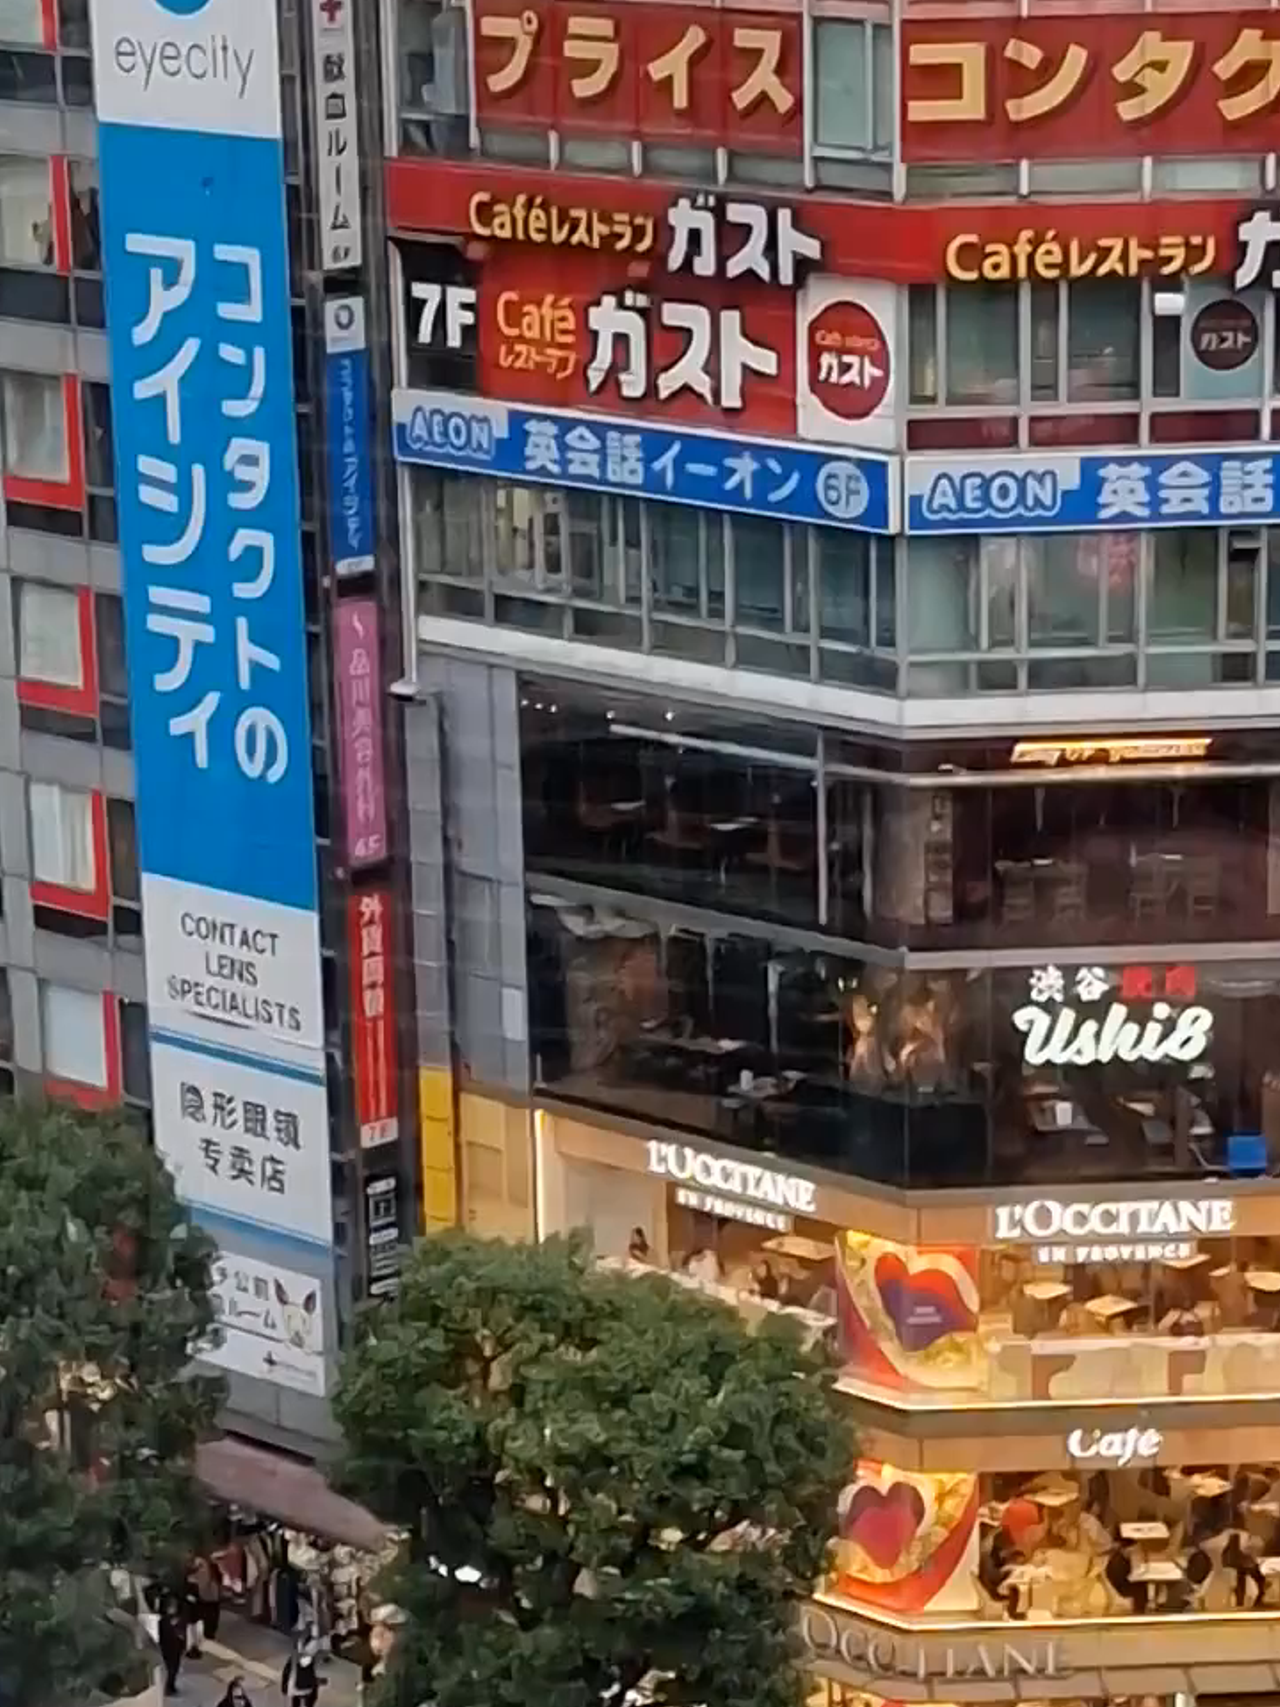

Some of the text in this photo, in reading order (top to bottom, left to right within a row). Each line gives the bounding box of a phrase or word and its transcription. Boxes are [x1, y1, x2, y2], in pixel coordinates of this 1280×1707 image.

[114, 33, 255, 100] eyecity
[479, 9, 795, 115] プライス
[666, 193, 823, 286] ガスト
[410, 281, 477, 348] 7F
[495, 292, 577, 344] Café
[586, 291, 778, 410] ガスト
[407, 409, 496, 457] AEON
[122, 229, 223, 772] アイシティ
[212, 239, 291, 787] コンタクトの
[821, 468, 864, 511] 6F
[923, 468, 1064, 519] AEON
[179, 910, 281, 959] CONTACT
[203, 951, 259, 989] LENS
[166, 974, 303, 1033] SPECIALISTS
[197, 1137, 287, 1195] 专卖店
[993, 1198, 1236, 1240] L'OCCITANE
[1065, 1426, 1164, 1468] Café
